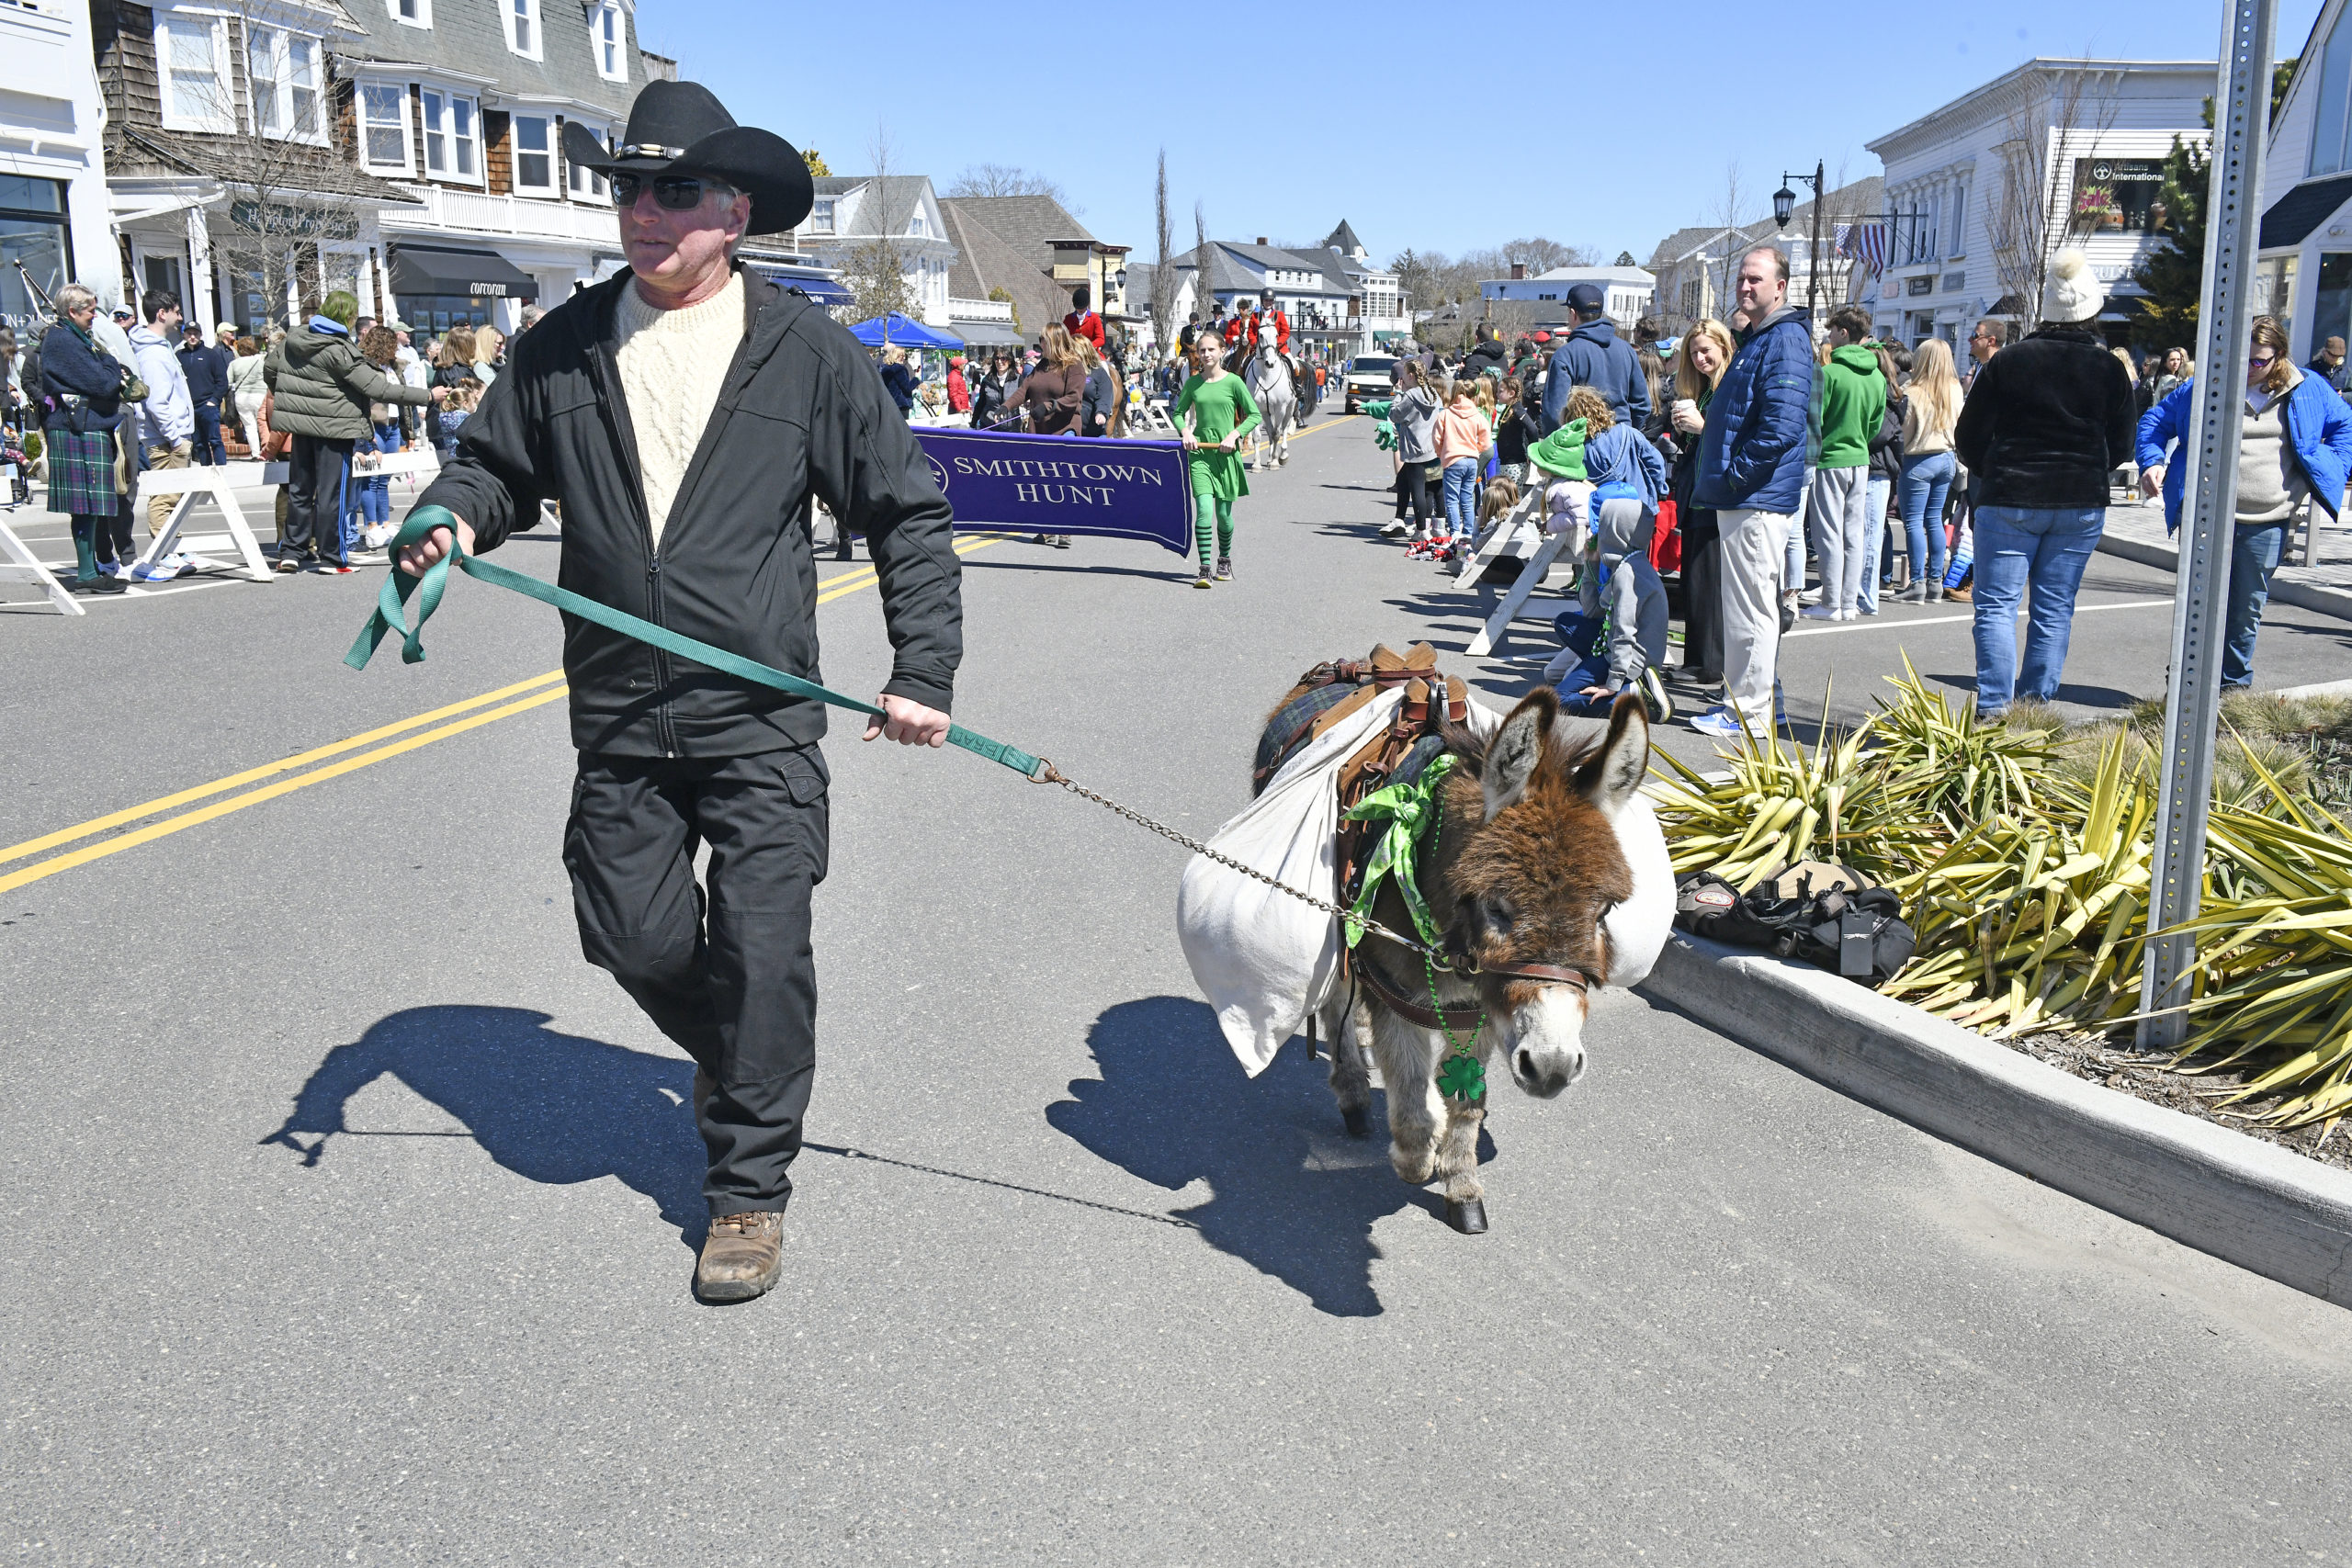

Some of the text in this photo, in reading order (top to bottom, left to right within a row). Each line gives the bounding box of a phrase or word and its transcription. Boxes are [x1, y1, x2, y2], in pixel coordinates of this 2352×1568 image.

[470, 282, 506, 296] corcoran
[954, 457, 1162, 487] SMITHTOWN
[1014, 483, 1115, 506] HUNT
